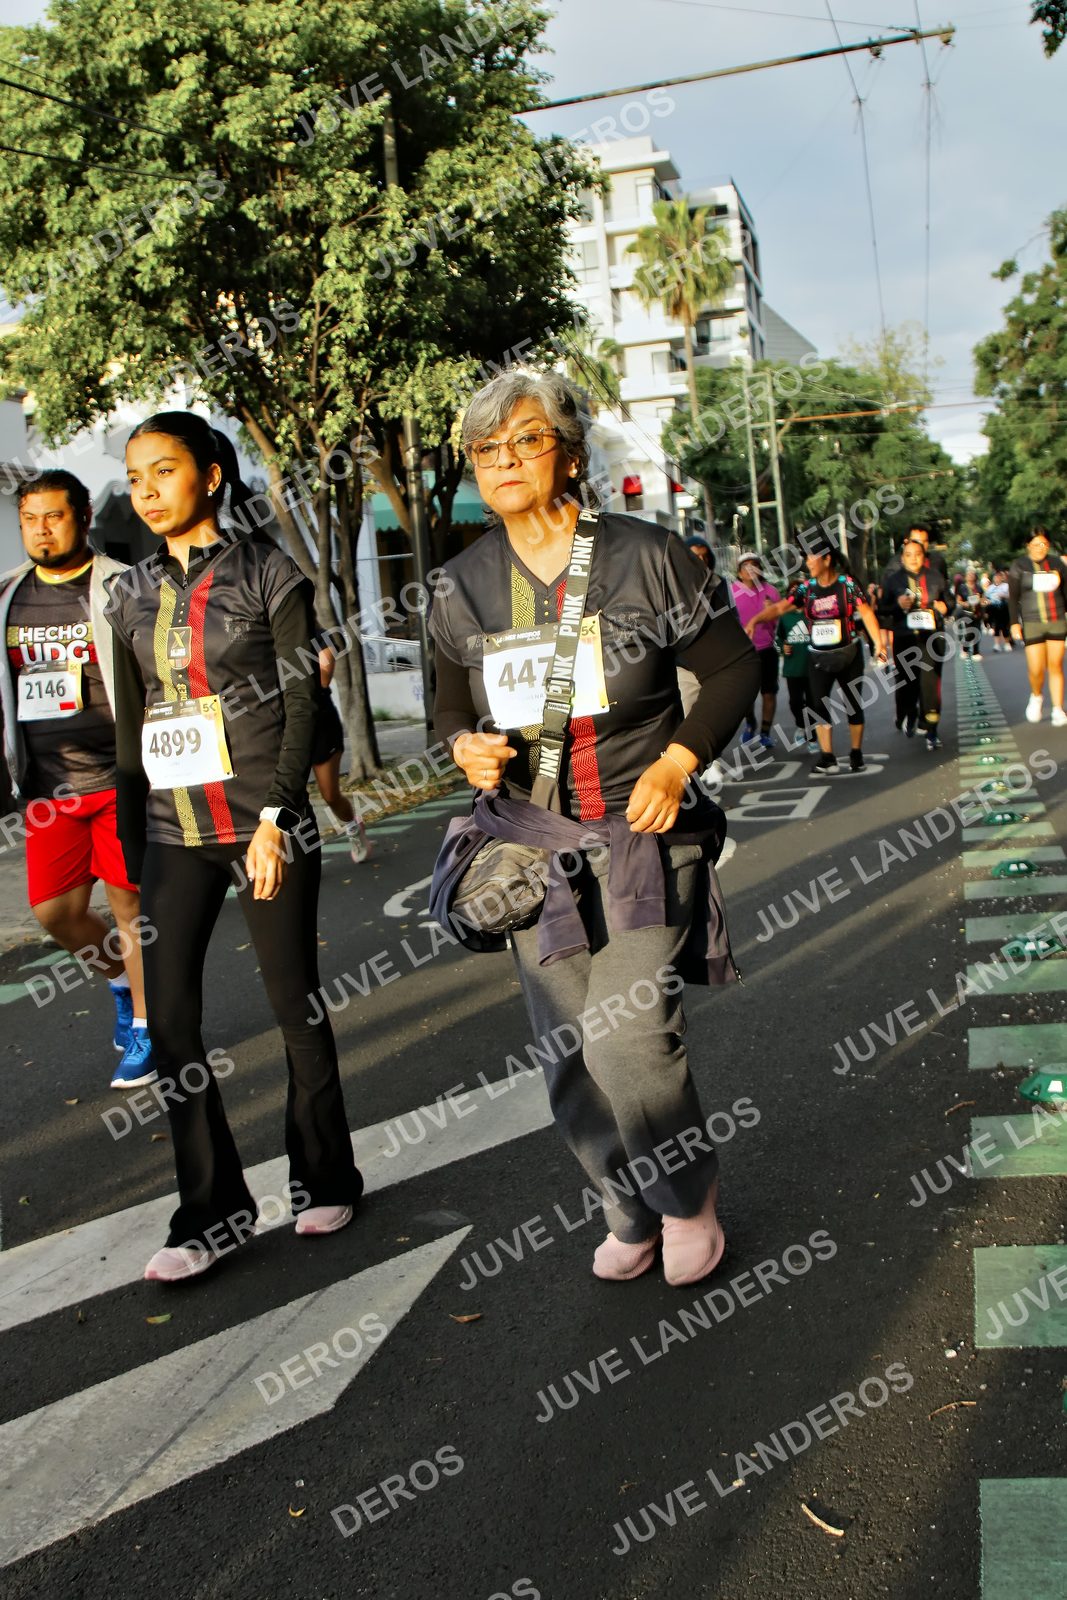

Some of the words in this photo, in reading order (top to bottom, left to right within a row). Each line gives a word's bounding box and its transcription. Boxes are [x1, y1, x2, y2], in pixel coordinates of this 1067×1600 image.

[569, 534, 595, 577] PINK
[559, 593, 585, 637] PINK
[18, 623, 88, 643] HECHO
[20, 640, 90, 665] UDG
[25, 679, 66, 700] 2146
[549, 653, 575, 694] PINK
[149, 727, 202, 758] 4899
[538, 745, 560, 779] INK
